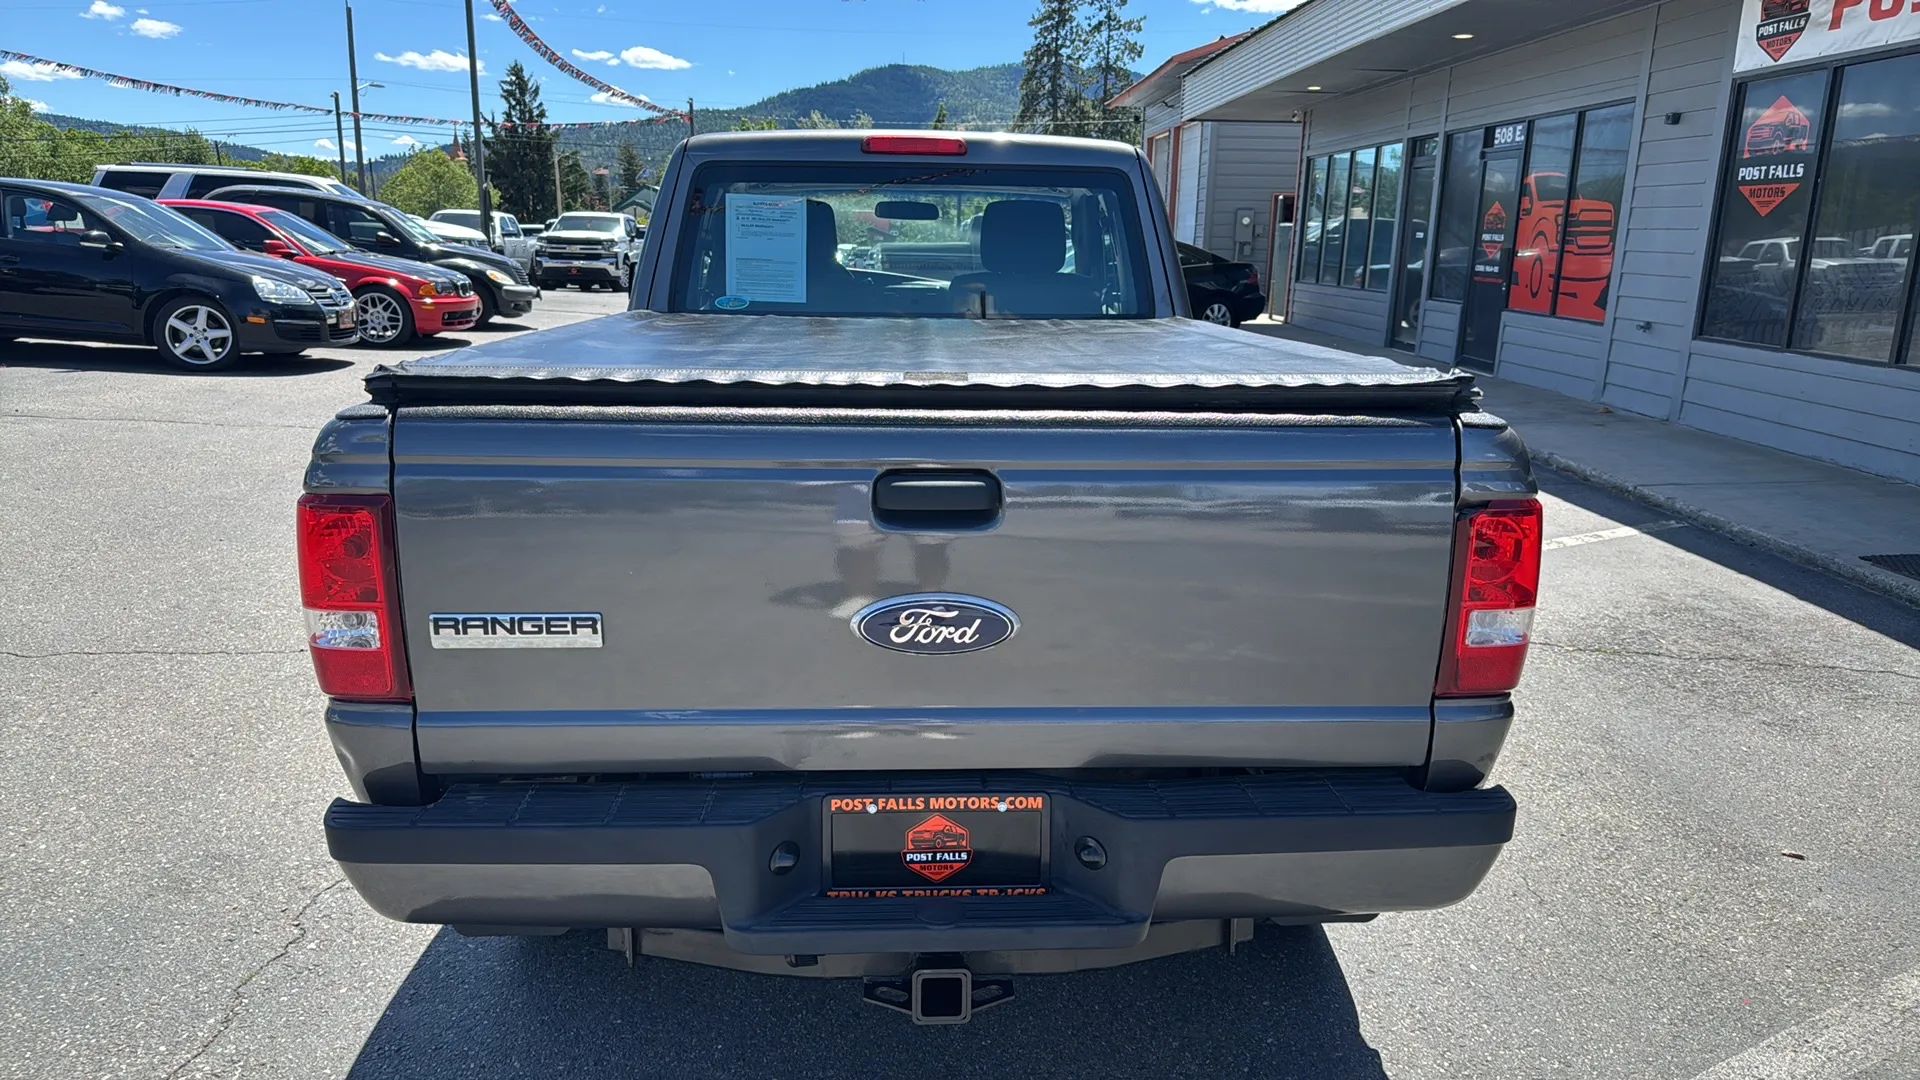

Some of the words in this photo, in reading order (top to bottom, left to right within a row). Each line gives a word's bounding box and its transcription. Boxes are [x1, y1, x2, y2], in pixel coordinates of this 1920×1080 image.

[1758, 23, 1778, 37] POST
[1779, 17, 1806, 32] FALLS
[1494, 127, 1513, 144] 508
[1515, 125, 1524, 141] E.
[1738, 166, 1767, 180] POST
[1768, 163, 1804, 179] FALLS
[1749, 187, 1785, 198] MOTORS
[432, 616, 599, 635] RANGER
[889, 608, 982, 644] Ford
[878, 798, 925, 810] FALLS
[906, 853, 933, 861] POST
[936, 852, 968, 861] FALLS
